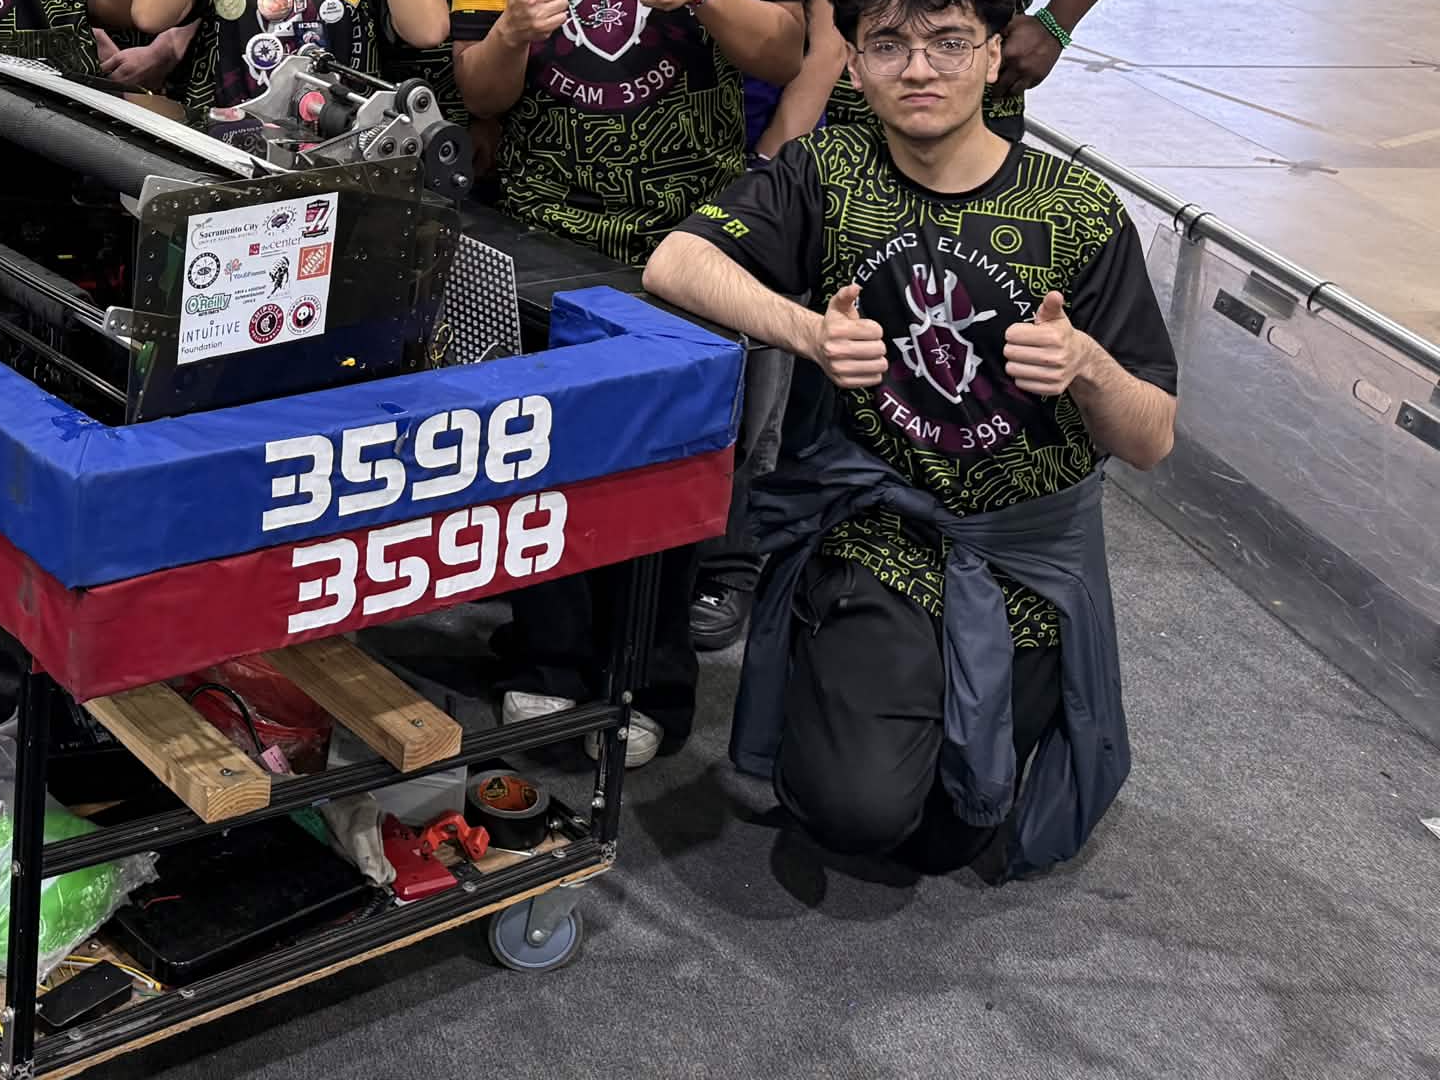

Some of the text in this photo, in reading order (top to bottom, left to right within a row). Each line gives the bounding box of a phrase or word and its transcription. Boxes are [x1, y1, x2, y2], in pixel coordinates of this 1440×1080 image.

[548, 59, 676, 105] TEAM 3598
[199, 225, 243, 239] Sacramento
[243, 223, 259, 233] City
[269, 236, 302, 249] center
[185, 293, 232, 315] O'Reilly
[181, 341, 223, 354] Foundation
[879, 391, 942, 444] TEAM
[261, 393, 554, 532] 3598
[286, 490, 570, 635] 3598
